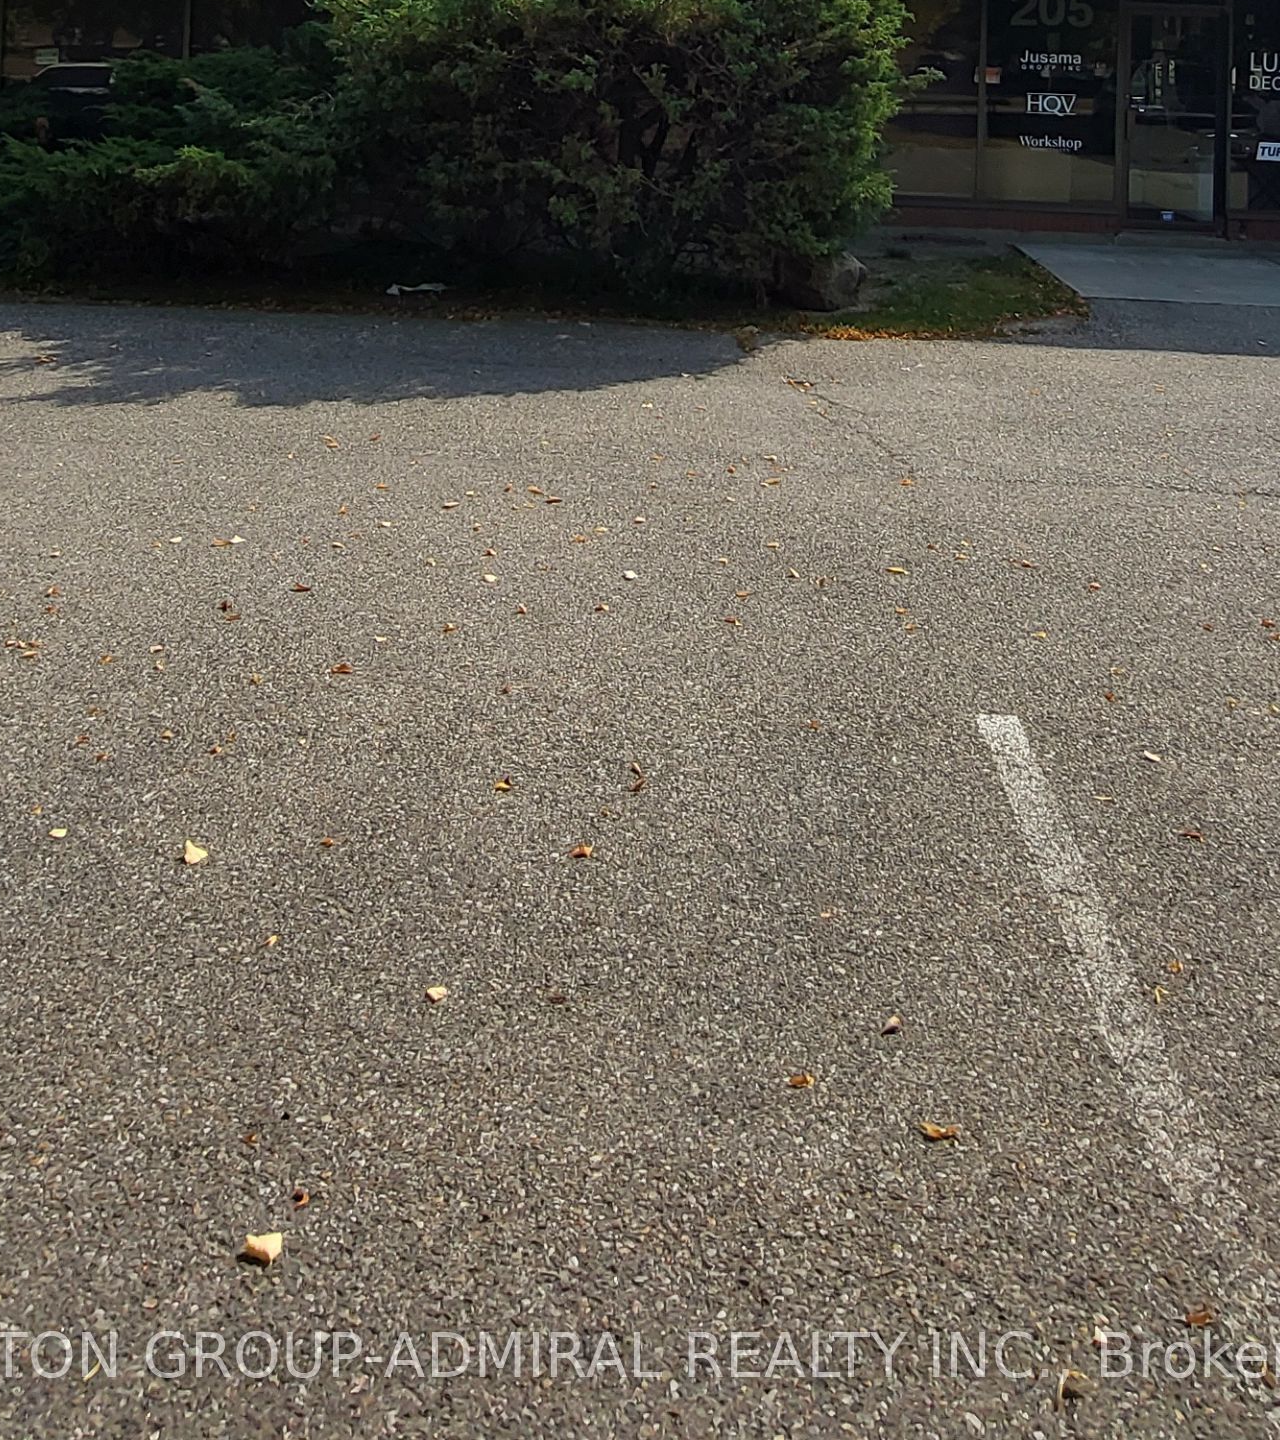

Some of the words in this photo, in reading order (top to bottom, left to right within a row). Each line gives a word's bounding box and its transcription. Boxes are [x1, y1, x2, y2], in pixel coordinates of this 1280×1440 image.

[1020, 49, 1082, 64] Jusama
[1027, 94, 1076, 116] HQV
[1019, 134, 1083, 151] Workshop
